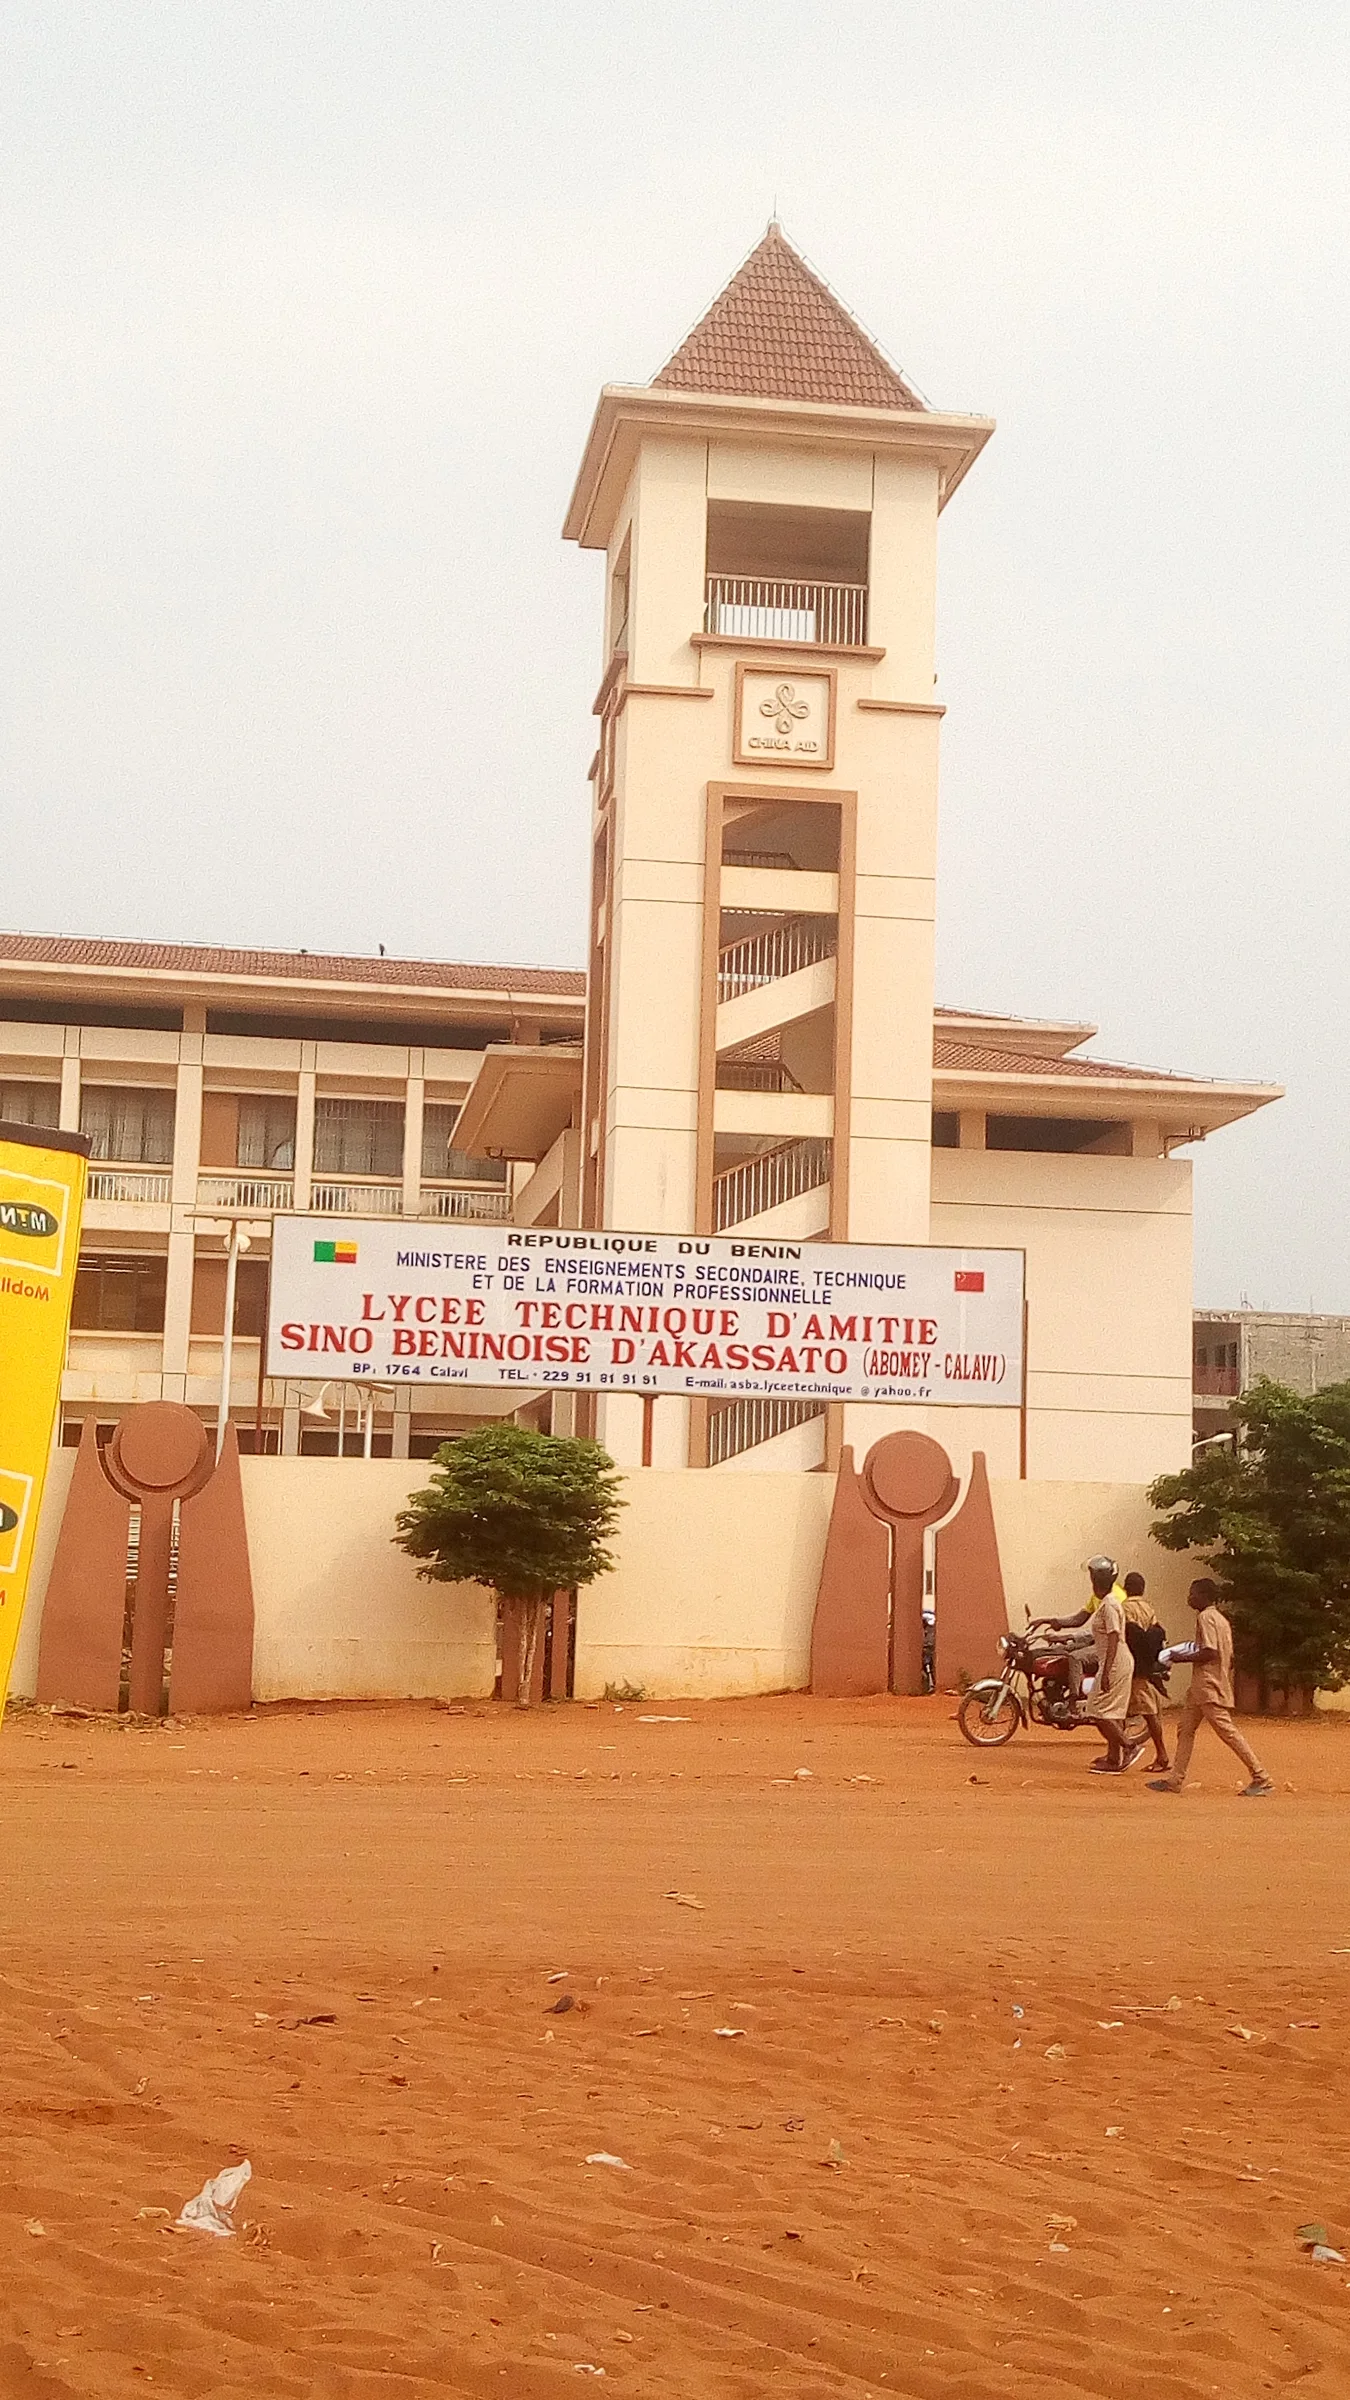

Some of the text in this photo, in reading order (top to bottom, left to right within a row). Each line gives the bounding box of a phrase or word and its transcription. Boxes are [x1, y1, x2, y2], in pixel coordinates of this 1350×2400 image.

[793, 740, 818, 753] AID
[508, 1234, 801, 1259] REPUBLIQUE DU BENIN
[397, 1252, 485, 1270] MINISTERE
[499, 1257, 530, 1271] DES
[546, 1258, 685, 1278] ENSEIGNEMENTS
[814, 1271, 905, 1291] TECHNIQUE
[473, 1275, 830, 1304] ET DE LA FORMATION PROFESSIONNELLE
[362, 1295, 937, 1344] LYCEE TECHNIQUE D'AMITIE
[281, 1324, 372, 1353] SINO
[392, 1329, 590, 1363] BENINOISE
[611, 1338, 847, 1374] D'AKASSATO
[386, 1365, 420, 1375] 1764
[431, 1367, 467, 1377] Calavi
[576, 1373, 590, 1382] 91
[623, 1374, 635, 1383] 91
[643, 1375, 656, 1384] 91
